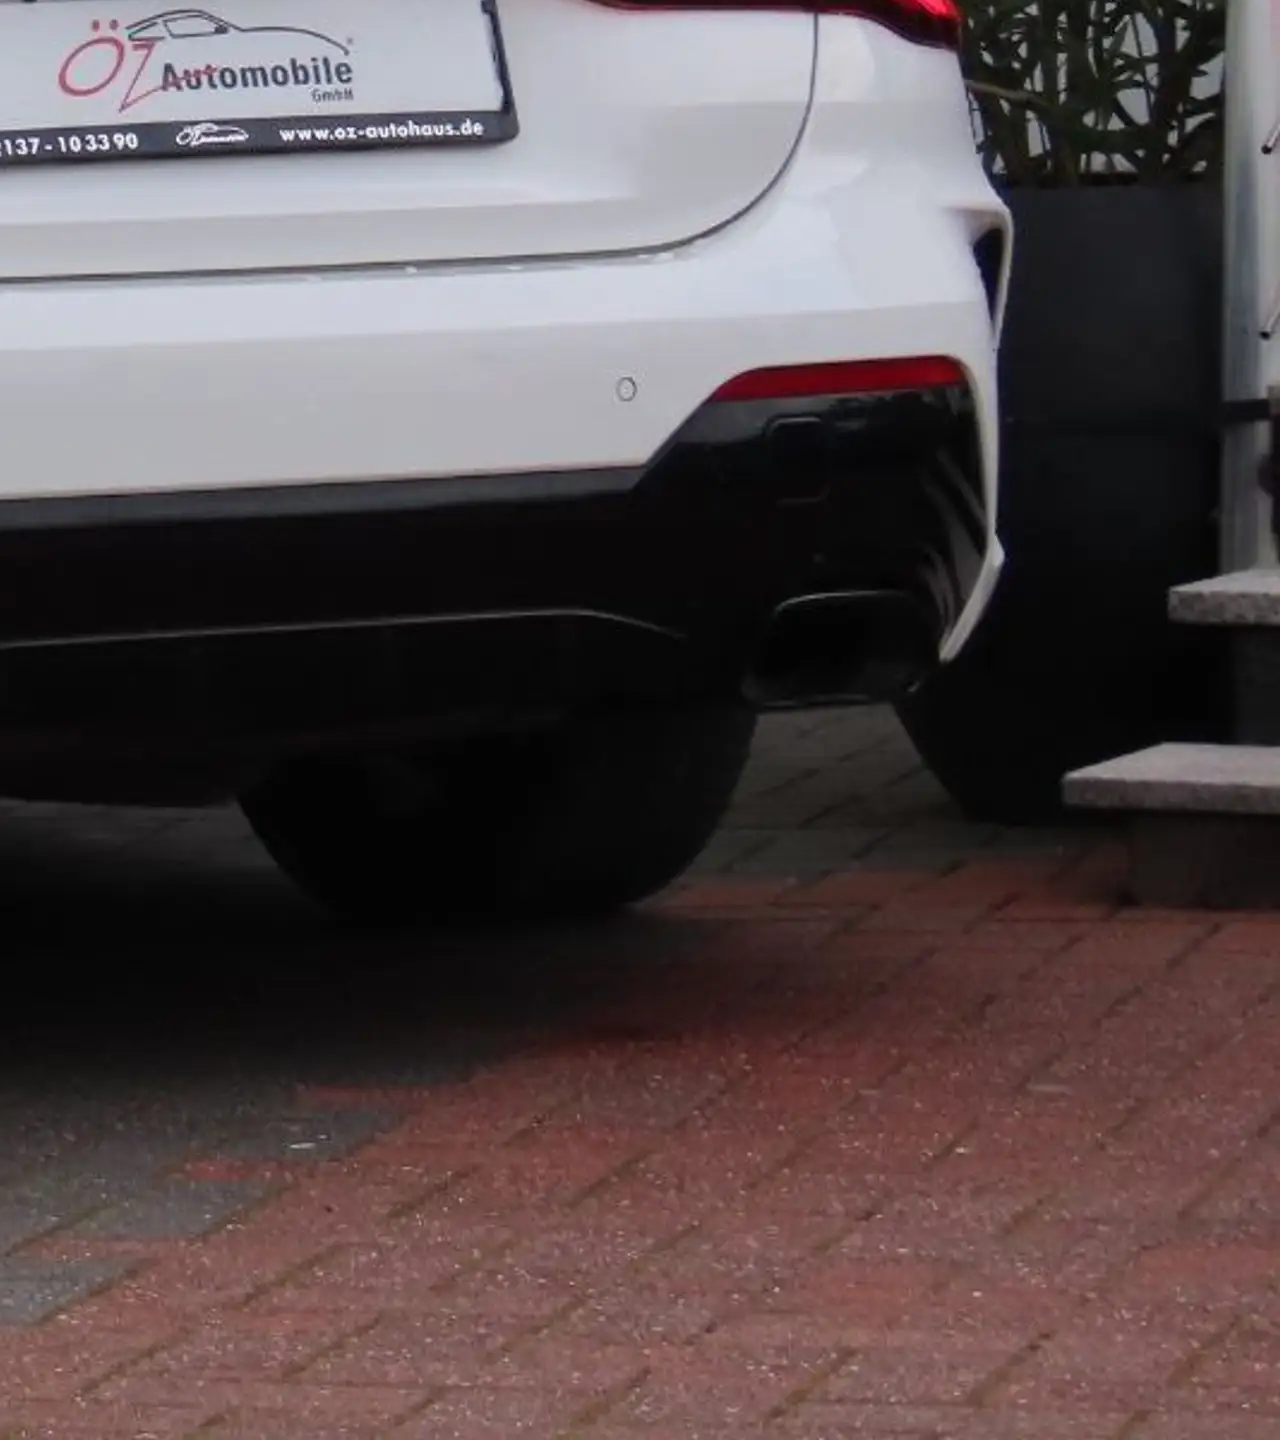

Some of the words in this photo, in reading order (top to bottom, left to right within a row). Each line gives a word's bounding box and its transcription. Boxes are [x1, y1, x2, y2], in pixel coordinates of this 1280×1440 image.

[160, 57, 354, 92] Automobile
[311, 87, 355, 103] GmbH
[279, 118, 484, 142] www.oz-autohaus.de
